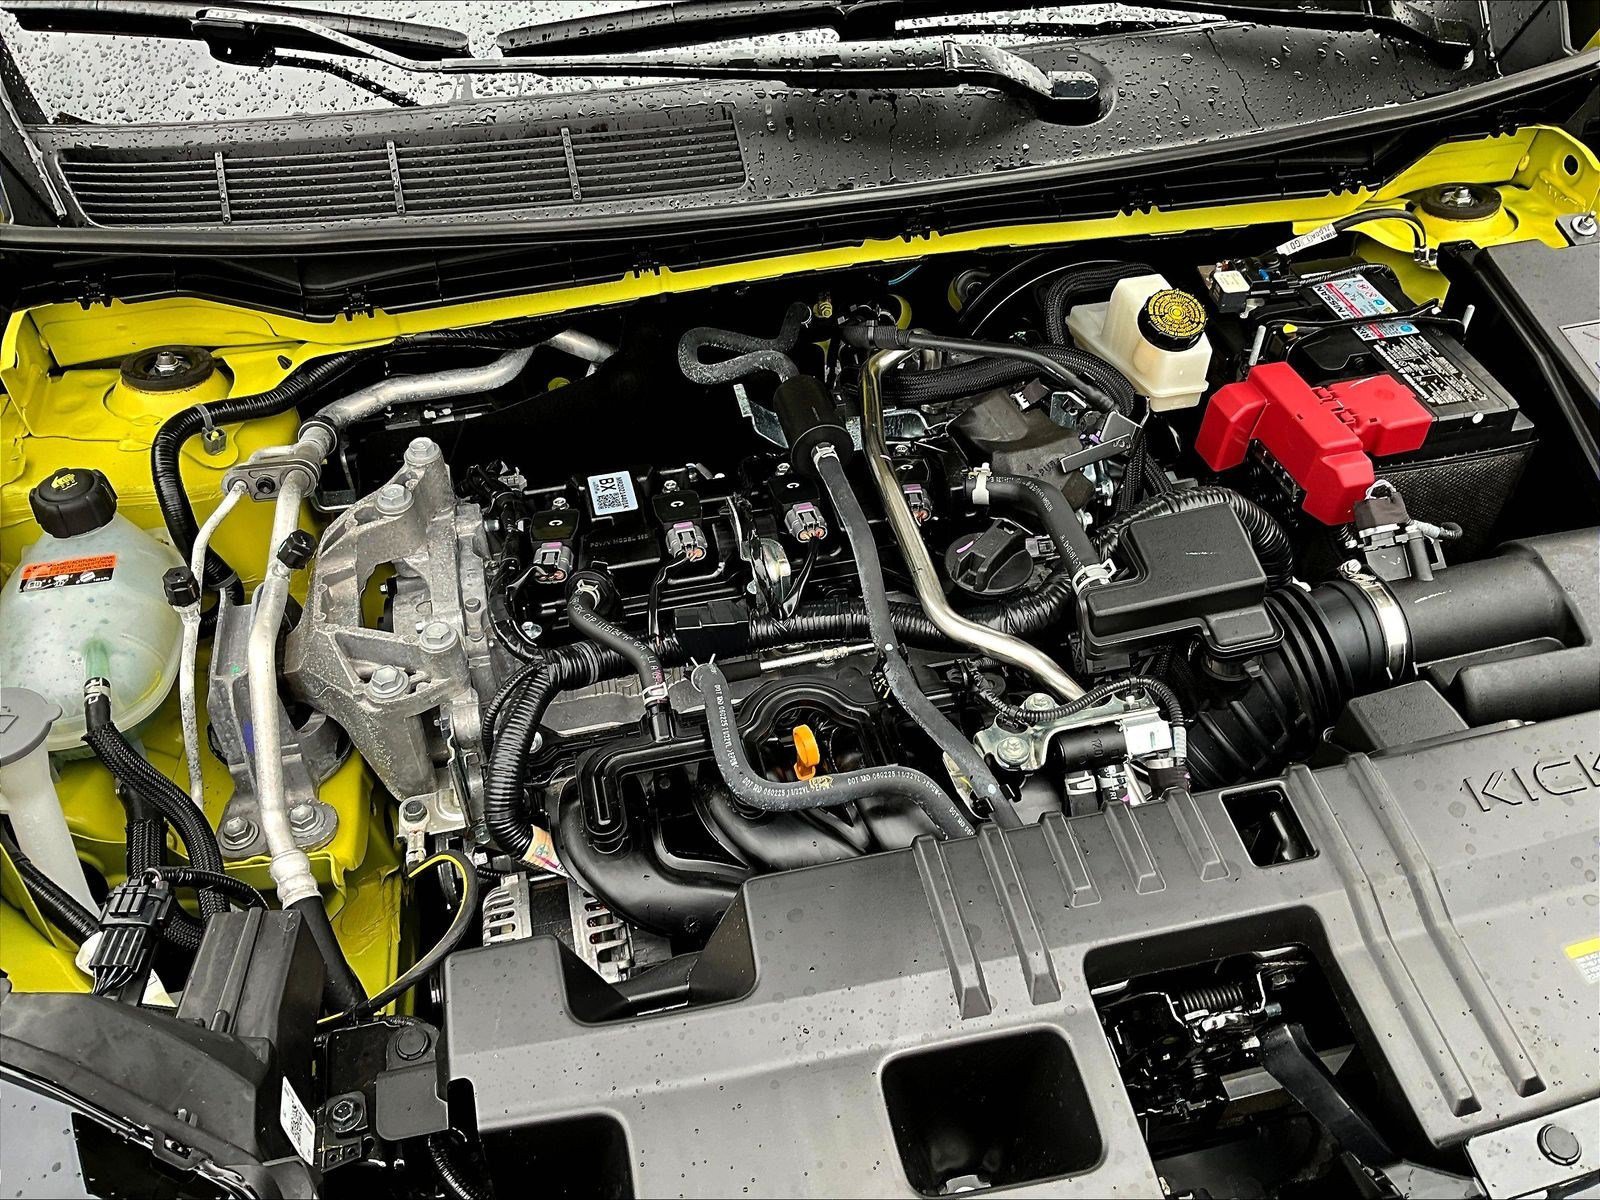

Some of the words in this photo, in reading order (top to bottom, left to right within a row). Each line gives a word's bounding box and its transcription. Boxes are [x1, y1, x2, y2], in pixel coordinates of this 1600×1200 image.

[1315, 285, 1346, 313] NISSAN
[599, 477, 616, 492] BX
[670, 500, 684, 508] C
